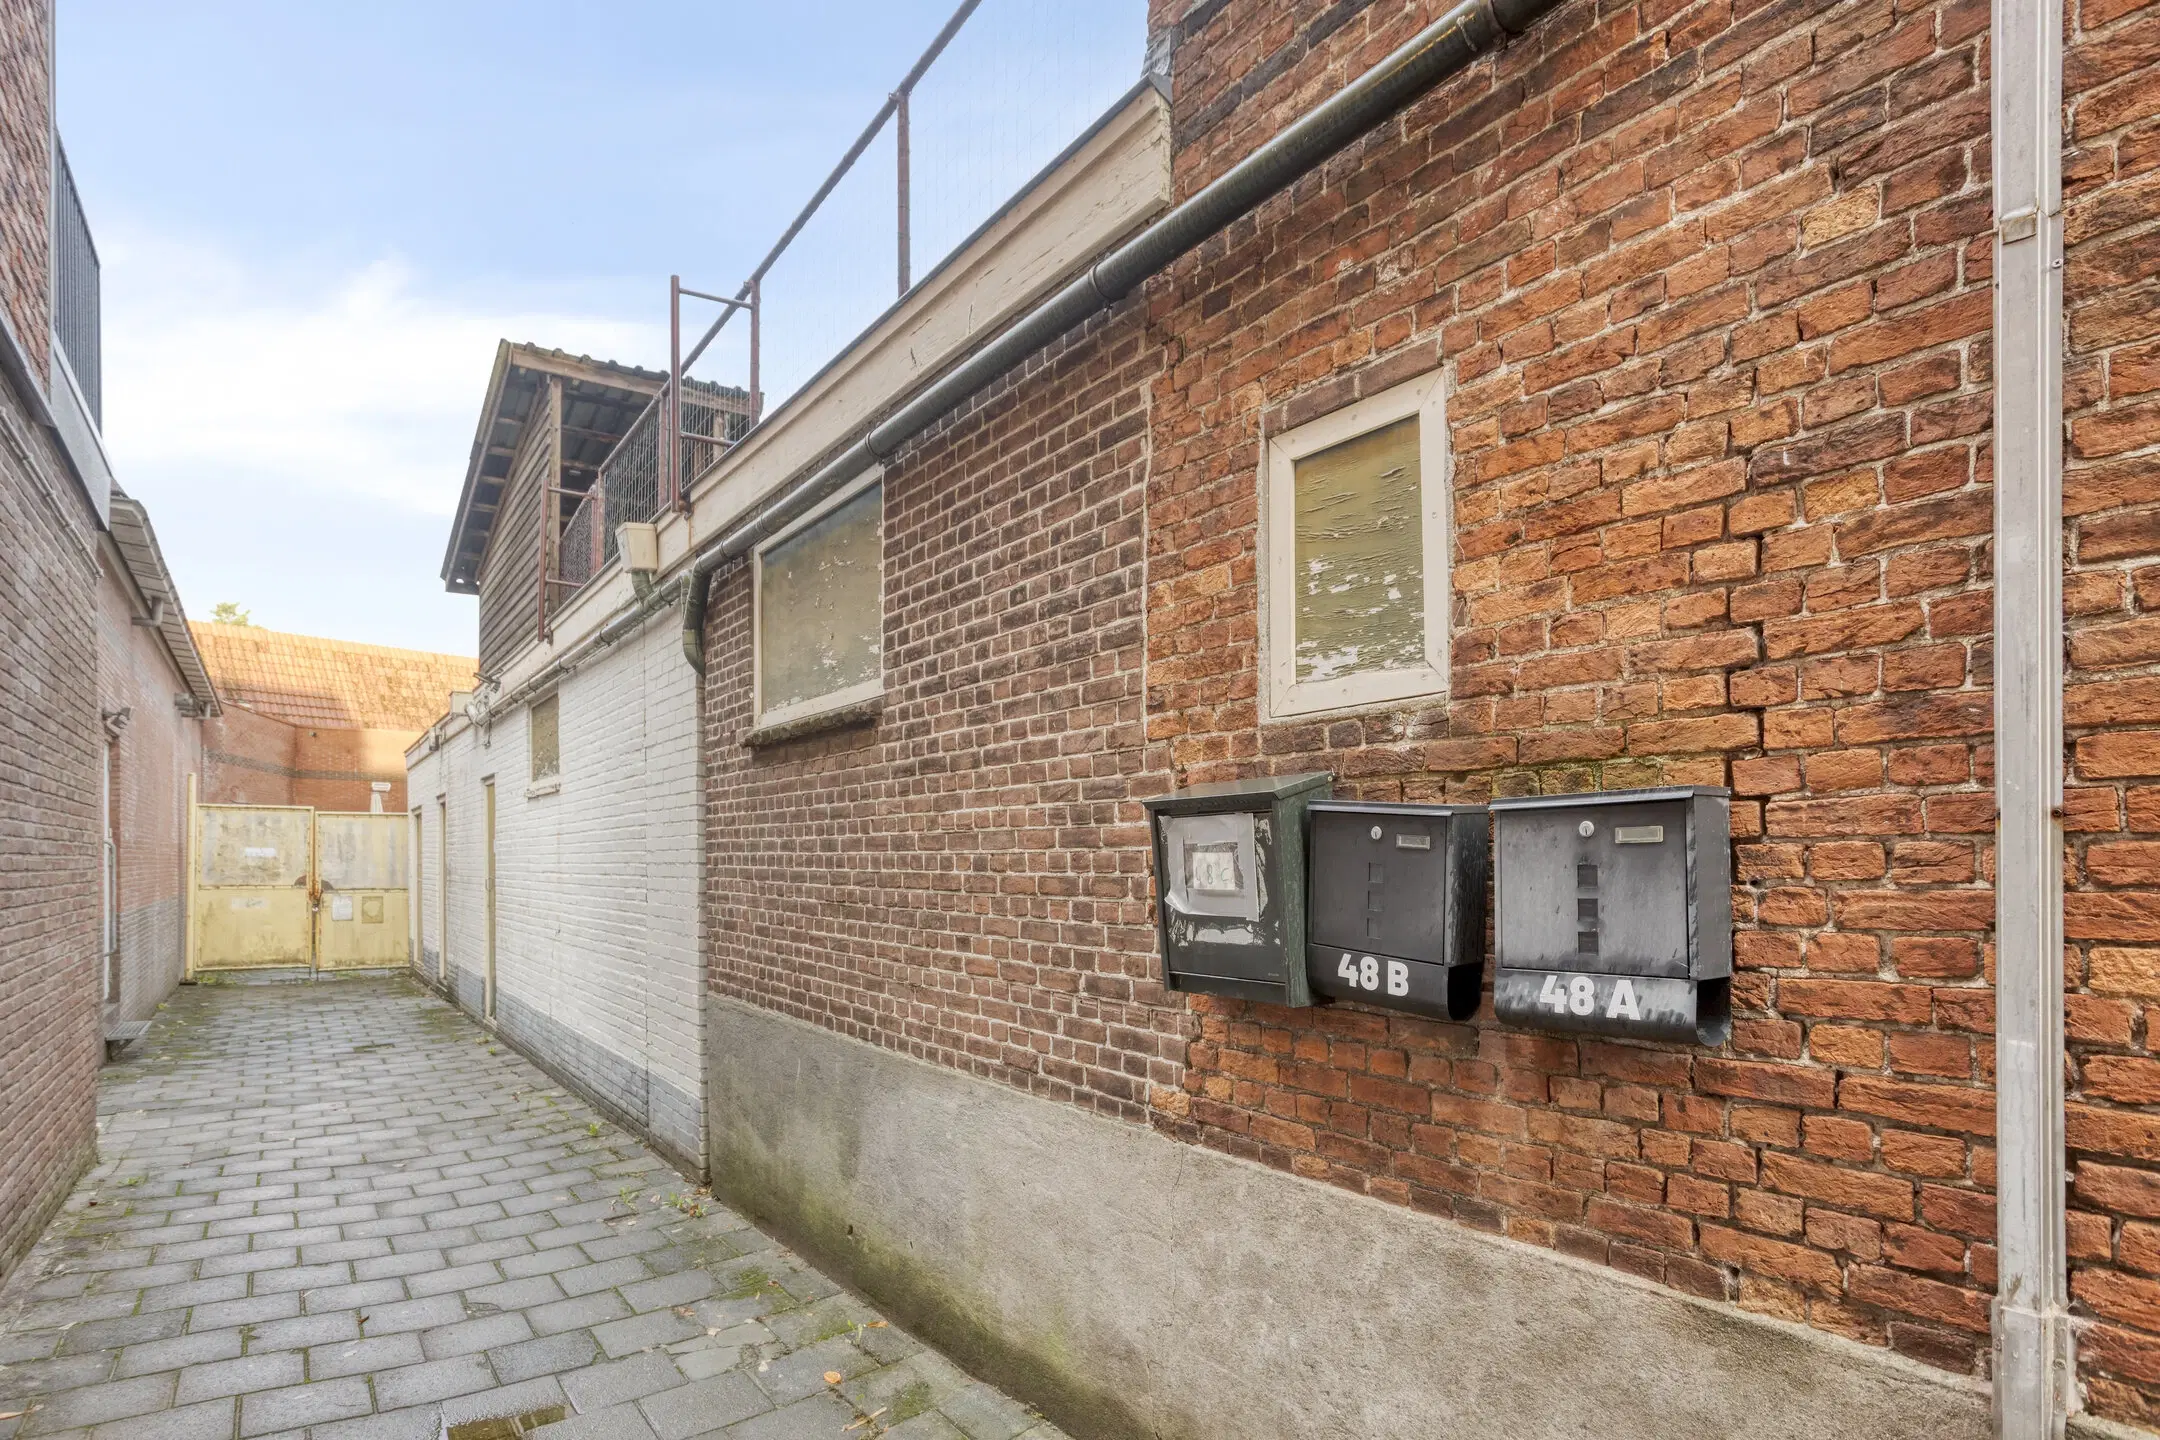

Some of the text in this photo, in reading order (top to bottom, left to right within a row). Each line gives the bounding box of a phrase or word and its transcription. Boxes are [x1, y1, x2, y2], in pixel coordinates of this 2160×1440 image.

[1337, 953, 1409, 997] 48 B
[1540, 975, 1641, 1020] 48 A
